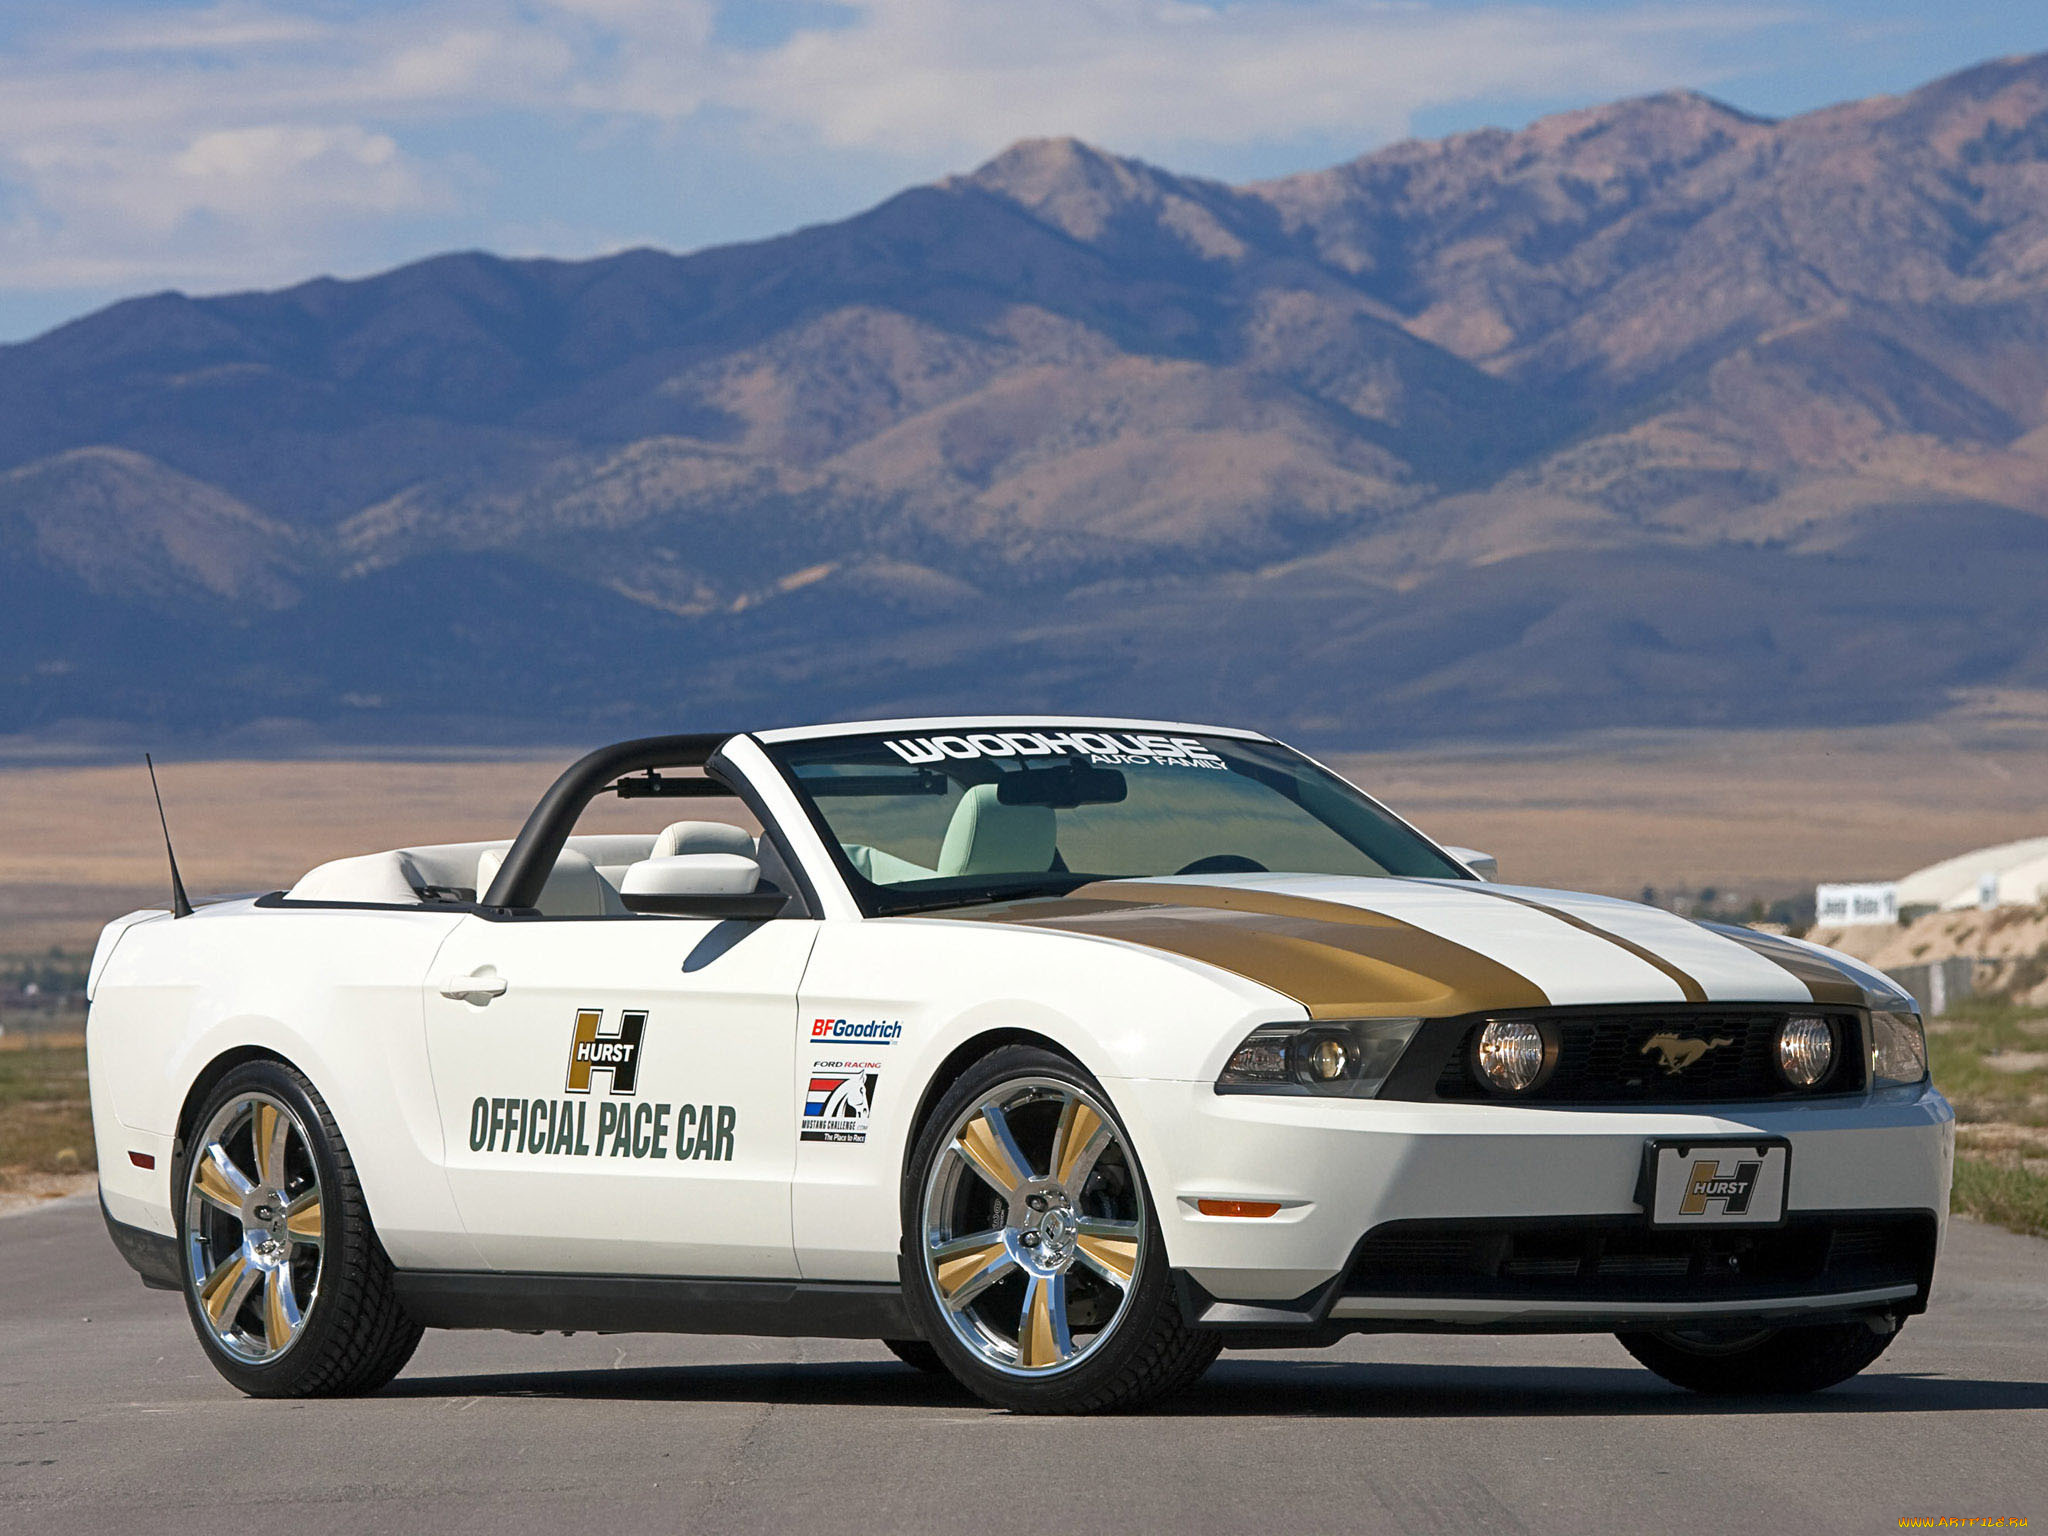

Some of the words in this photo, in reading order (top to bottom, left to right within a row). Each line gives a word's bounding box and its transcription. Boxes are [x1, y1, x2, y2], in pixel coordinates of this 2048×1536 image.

[884, 733, 1222, 764] WOODHOUSE
[1091, 754, 1150, 764] AUTO
[1152, 755, 1228, 770] FAMILY
[812, 1019, 902, 1038] BFGoodrich
[577, 1042, 634, 1062] HURST
[469, 1096, 589, 1156] OFFICIAL
[595, 1102, 671, 1159] PACE
[676, 1104, 736, 1161] CAR
[802, 1119, 826, 1129] MUSTANG
[1693, 1182, 1748, 1195] HURST
